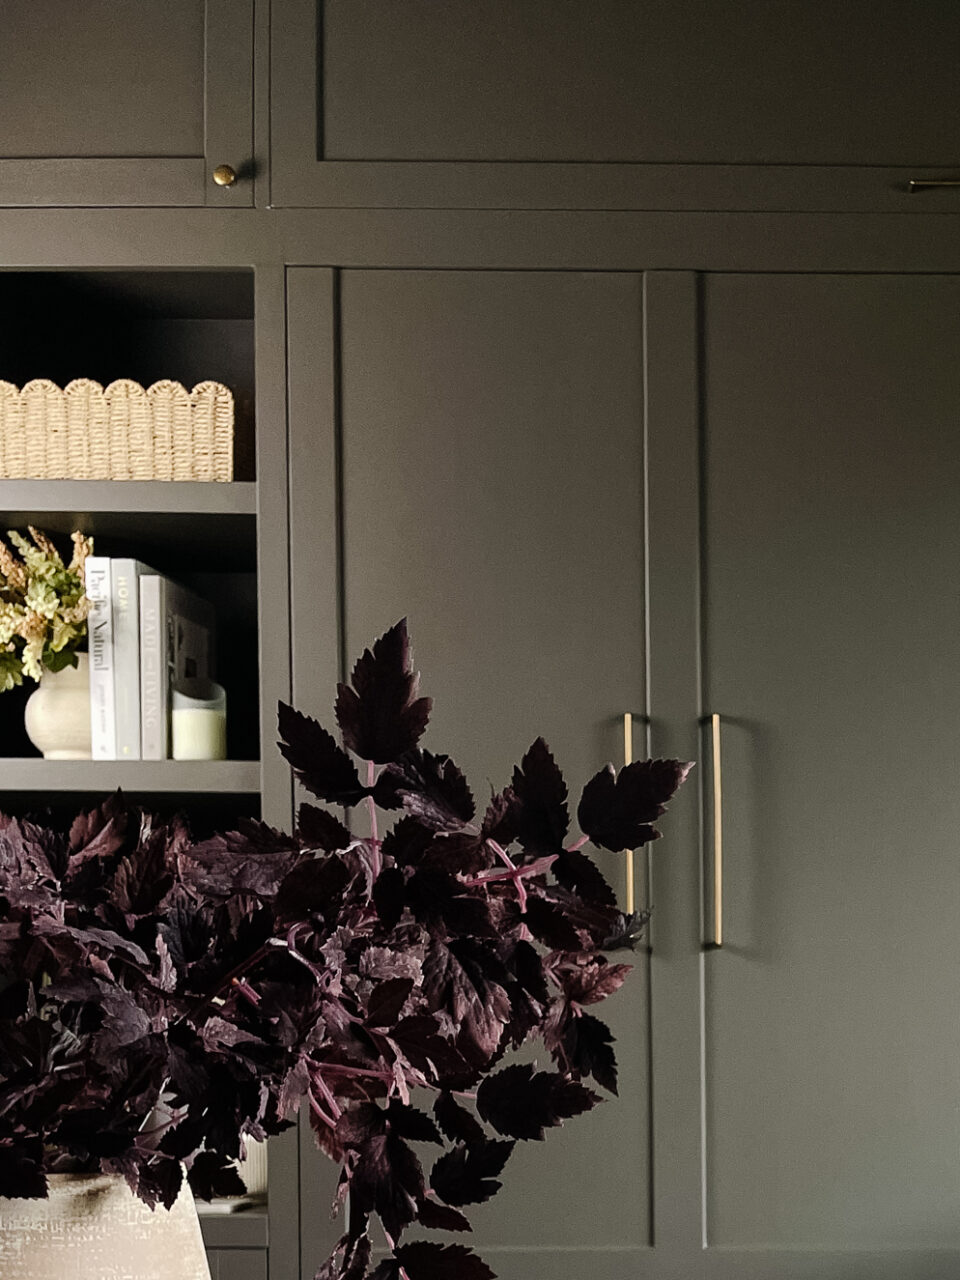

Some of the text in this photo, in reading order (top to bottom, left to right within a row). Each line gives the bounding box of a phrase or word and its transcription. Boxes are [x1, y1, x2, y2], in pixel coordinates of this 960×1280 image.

[117, 575, 129, 621] HOME
[93, 617, 109, 671] Natural
[145, 670, 157, 729] LIVING
